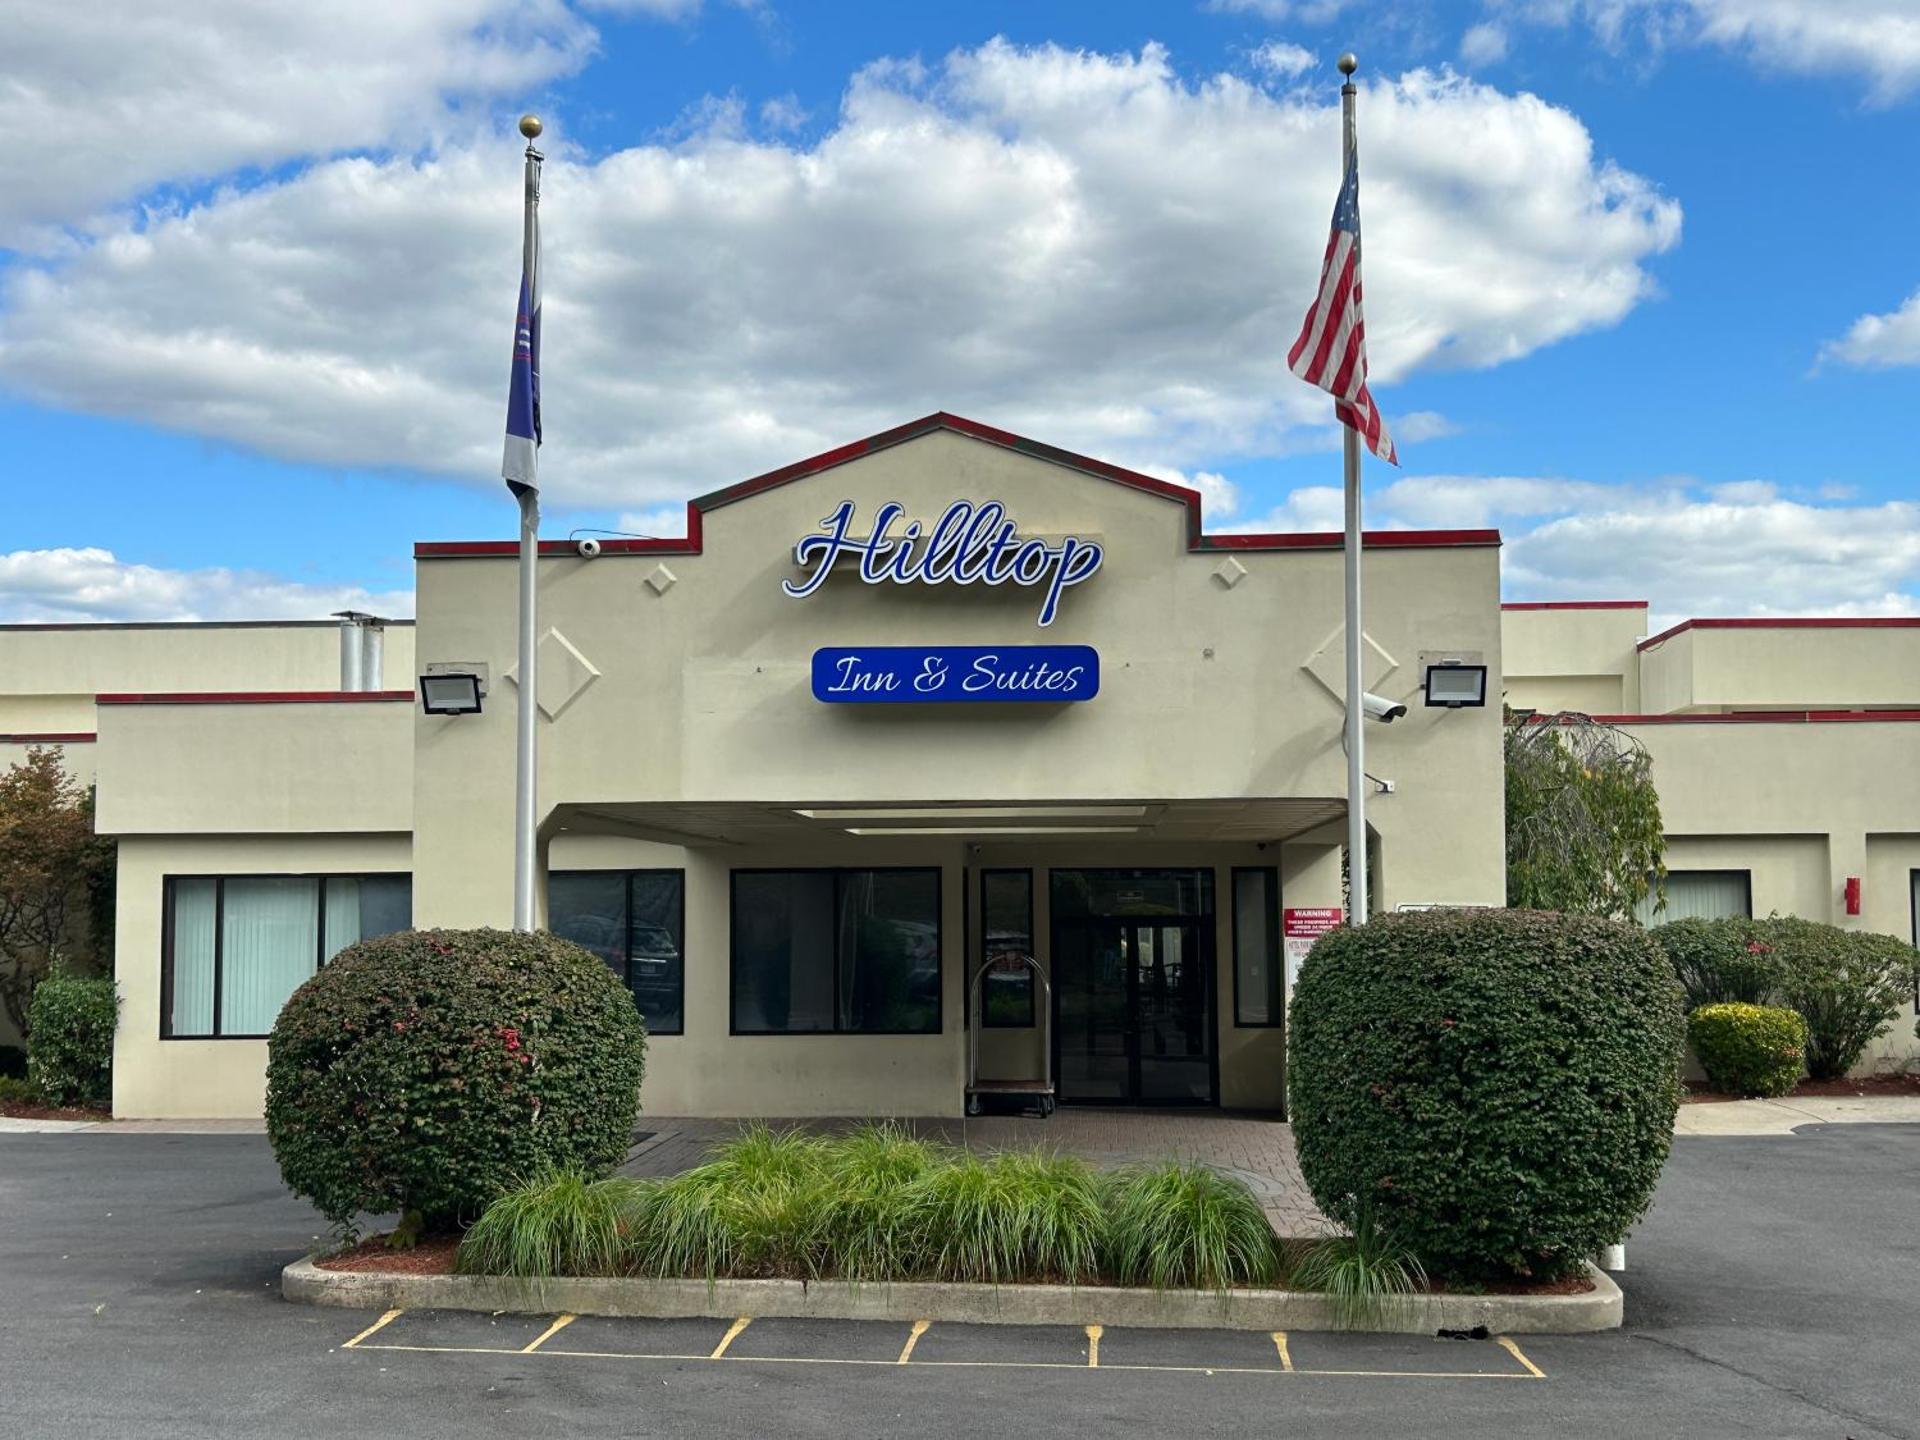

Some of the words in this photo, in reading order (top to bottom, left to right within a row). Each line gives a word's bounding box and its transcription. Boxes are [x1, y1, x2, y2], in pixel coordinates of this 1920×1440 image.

[782, 500, 1104, 626] Hilltop
[827, 656, 902, 692] Inn
[913, 656, 949, 692] &
[962, 655, 1084, 692] Suites
